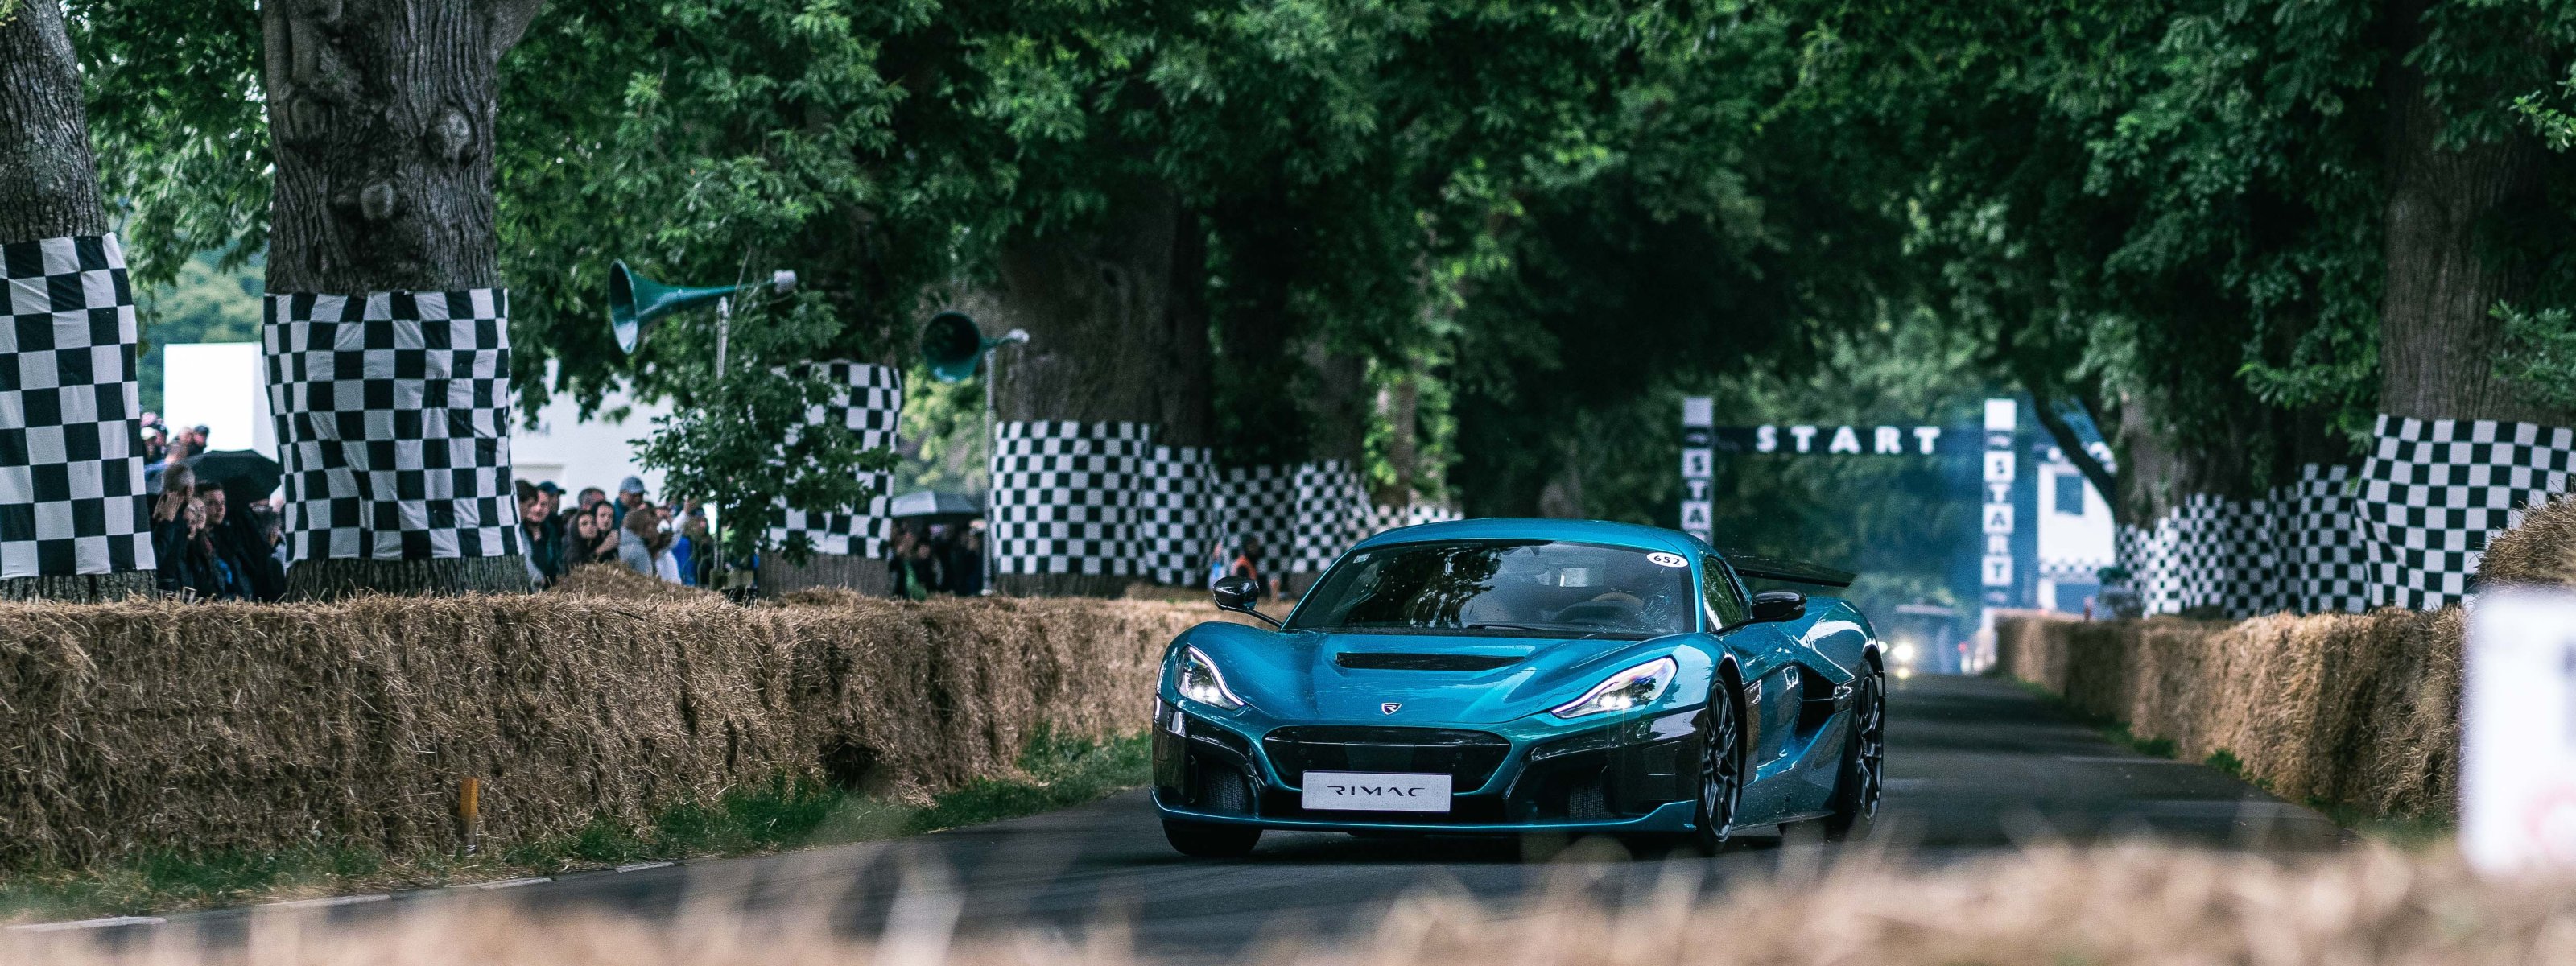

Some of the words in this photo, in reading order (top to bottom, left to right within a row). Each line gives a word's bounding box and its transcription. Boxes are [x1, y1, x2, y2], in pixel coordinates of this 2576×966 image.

[1756, 424, 1942, 455] START
[1988, 459, 2011, 580] START
[1653, 555, 1681, 565] 652
[1327, 786, 1426, 797] RIMAC
